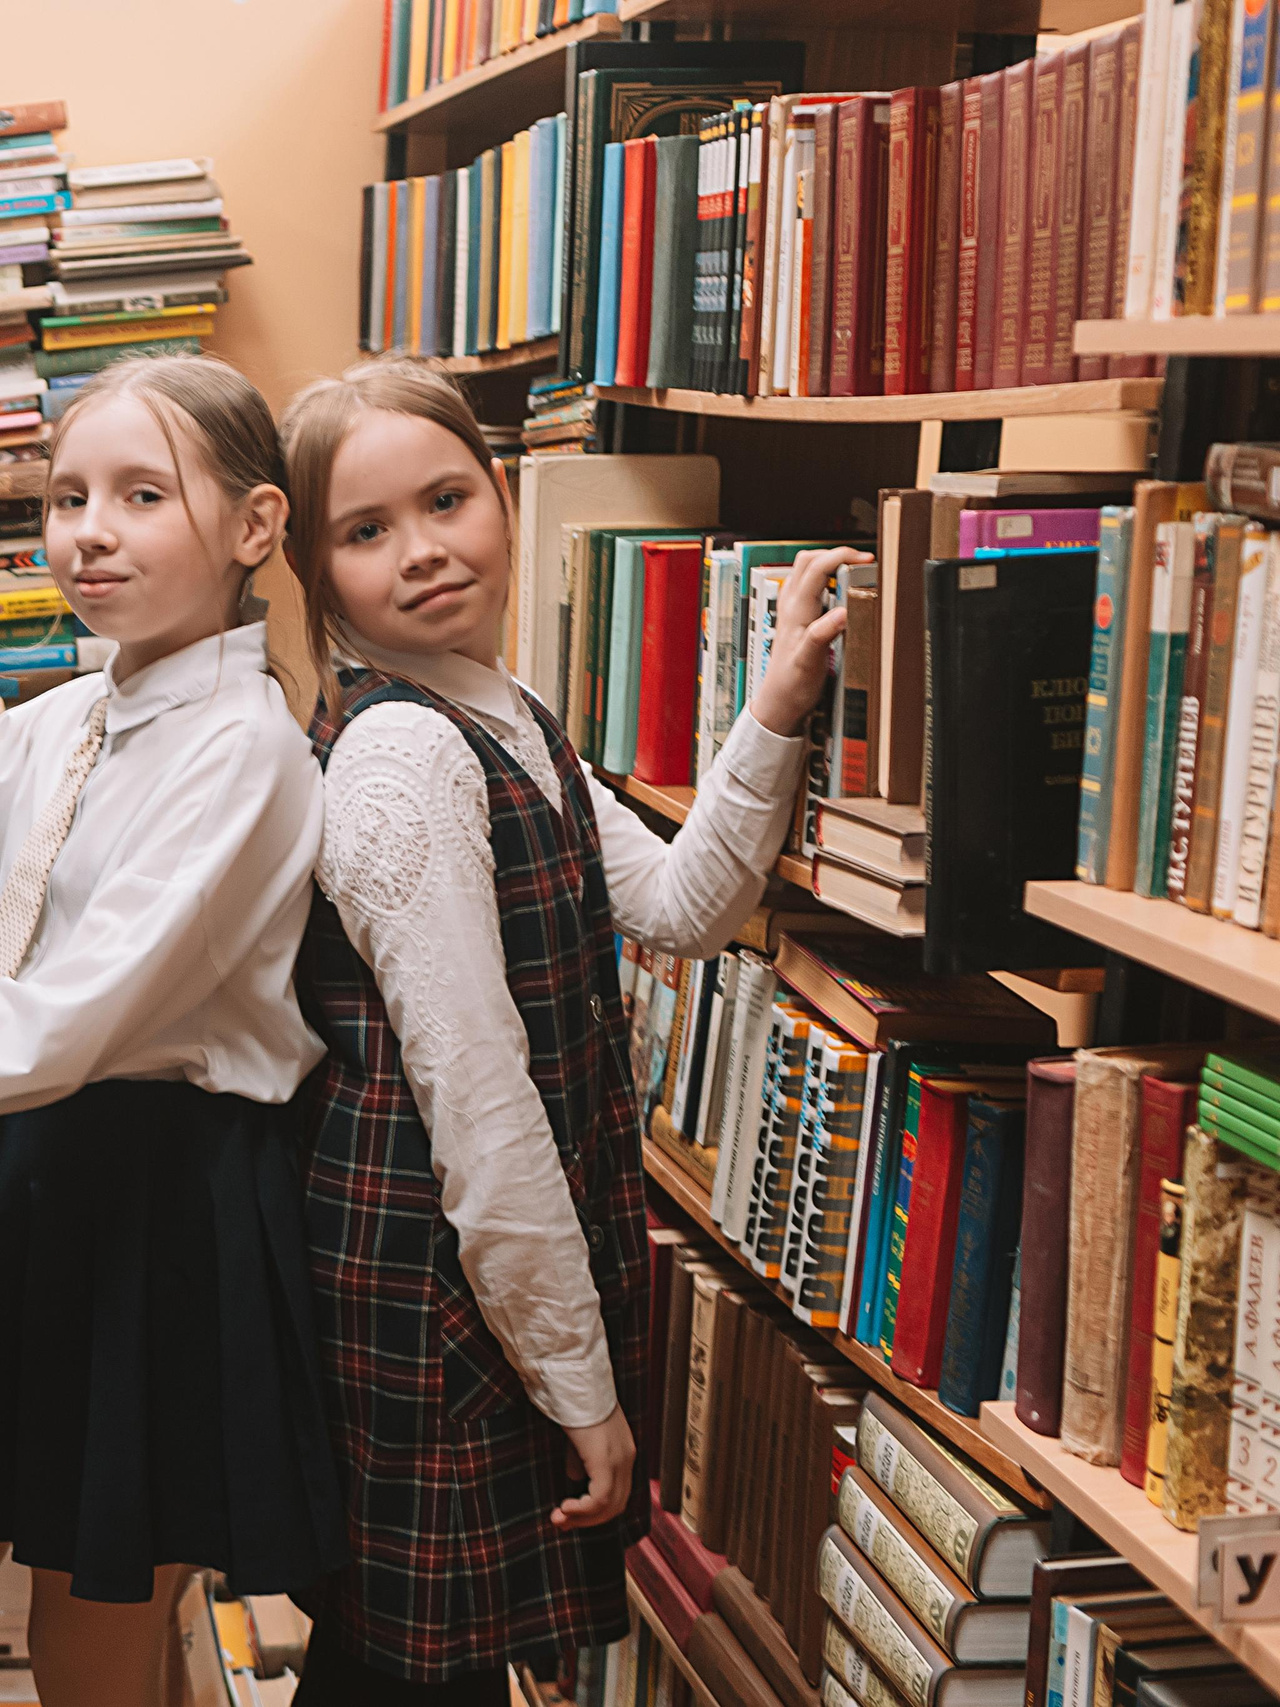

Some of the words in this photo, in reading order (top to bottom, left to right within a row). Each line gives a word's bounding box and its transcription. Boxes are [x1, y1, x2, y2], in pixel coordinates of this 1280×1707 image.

[1030, 677, 1088, 699] КЛЮ
[1171, 694, 1200, 831] ТУРГЕНЕВ
[1241, 693, 1277, 845] ТУРГЕНЕВ
[740, 1054, 751, 1089] МИРА
[872, 1113, 887, 1197] СЕРЕБРЯНЫЙ
[881, 1084, 891, 1110] ВЕК
[1243, 1234, 1264, 1331] ФАДЕЕВ
[1262, 1457, 1278, 1486] 2
